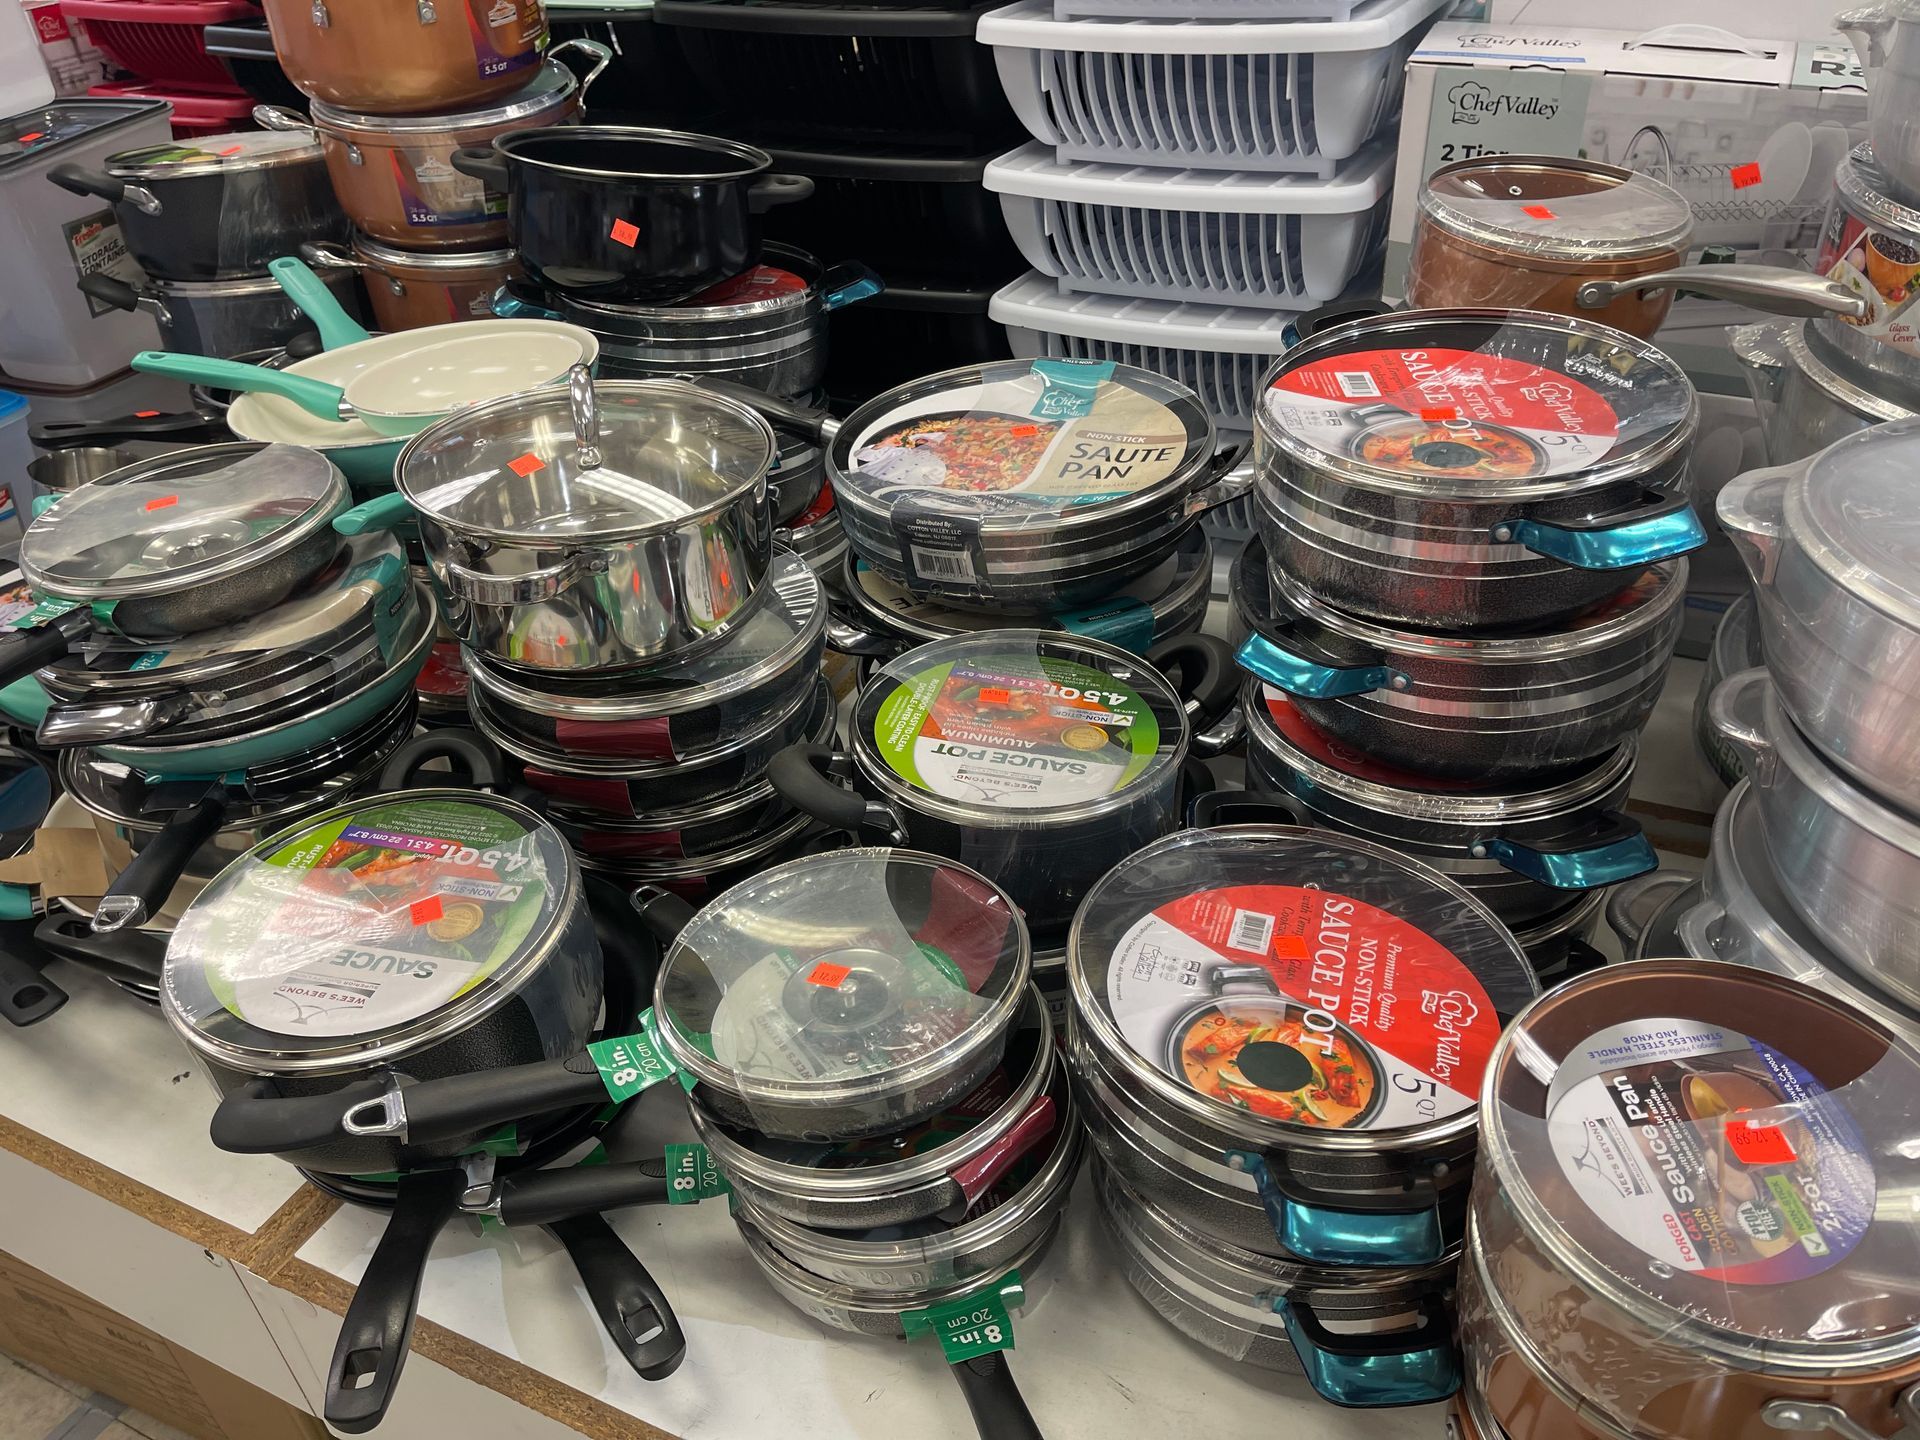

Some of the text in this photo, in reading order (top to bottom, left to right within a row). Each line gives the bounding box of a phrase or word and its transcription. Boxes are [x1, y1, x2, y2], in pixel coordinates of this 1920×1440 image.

[1441, 144, 1455, 161] 2
[81, 239, 120, 268] STORAGE
[1889, 323, 1911, 333] Glass
[1893, 333, 1917, 343] Cover
[1400, 351, 1456, 404] SAUCE
[1052, 395, 1085, 409] Chef
[1086, 432, 1146, 444] NON-STICK
[1540, 435, 1592, 456] 5 QT
[1069, 443, 1177, 464] SAUTE
[1058, 461, 1133, 480] PAN
[1083, 690, 1128, 705] 4.5
[894, 732, 910, 752] CLEAN
[940, 728, 1037, 748] ALUMINUM
[931, 743, 1088, 775] SAUCE POT
[956, 774, 1038, 790] WEE'S BEYOND
[392, 820, 414, 828] CHINA
[414, 841, 435, 850] 4.3
[479, 851, 529, 872] 4.5
[438, 883, 495, 897] NON-STICK
[330, 950, 438, 979] SAUCE
[1299, 898, 1355, 1056] SAUCE POT
[1348, 936, 1378, 1028] NON-STICK
[1374, 943, 1402, 1032] Premium Quality
[278, 985, 366, 1005] WEE'S BEYOND
[1587, 1032, 1723, 1059] STAINLESS STEEL HANDLE
[1623, 1029, 1678, 1044] AND KNOB
[611, 1045, 638, 1087] 8 in.
[636, 1042, 662, 1073] 20 cm
[1781, 1064, 1797, 1084] CHINA
[1392, 1073, 1437, 1119] 5 QT
[1649, 1088, 1670, 1119] Handle
[1644, 1098, 1659, 1116] and
[1654, 1113, 1666, 1128] Lid
[1612, 1075, 1695, 1204] Sauce Pan
[1663, 1126, 1680, 1153] Glass
[1736, 1130, 1768, 1145] 12.99
[1588, 1120, 1633, 1197] WEE'S BEYOND
[673, 1152, 696, 1191] 8 in.
[703, 1171, 718, 1188] 20
[1797, 1176, 1820, 1198] QT
[1771, 1181, 1805, 1231] NON-STICK
[1812, 1200, 1842, 1231] 2.5
[1679, 1211, 1702, 1241] CAST
[1741, 1207, 1766, 1235] PFOA
[1757, 1208, 1778, 1231] FREE
[1662, 1213, 1696, 1263] FORGED
[1692, 1208, 1724, 1253] GOLDEN
[1705, 1206, 1737, 1255] COATING
[947, 1308, 993, 1329] 20 cm
[952, 1325, 1003, 1344] 8 in.
